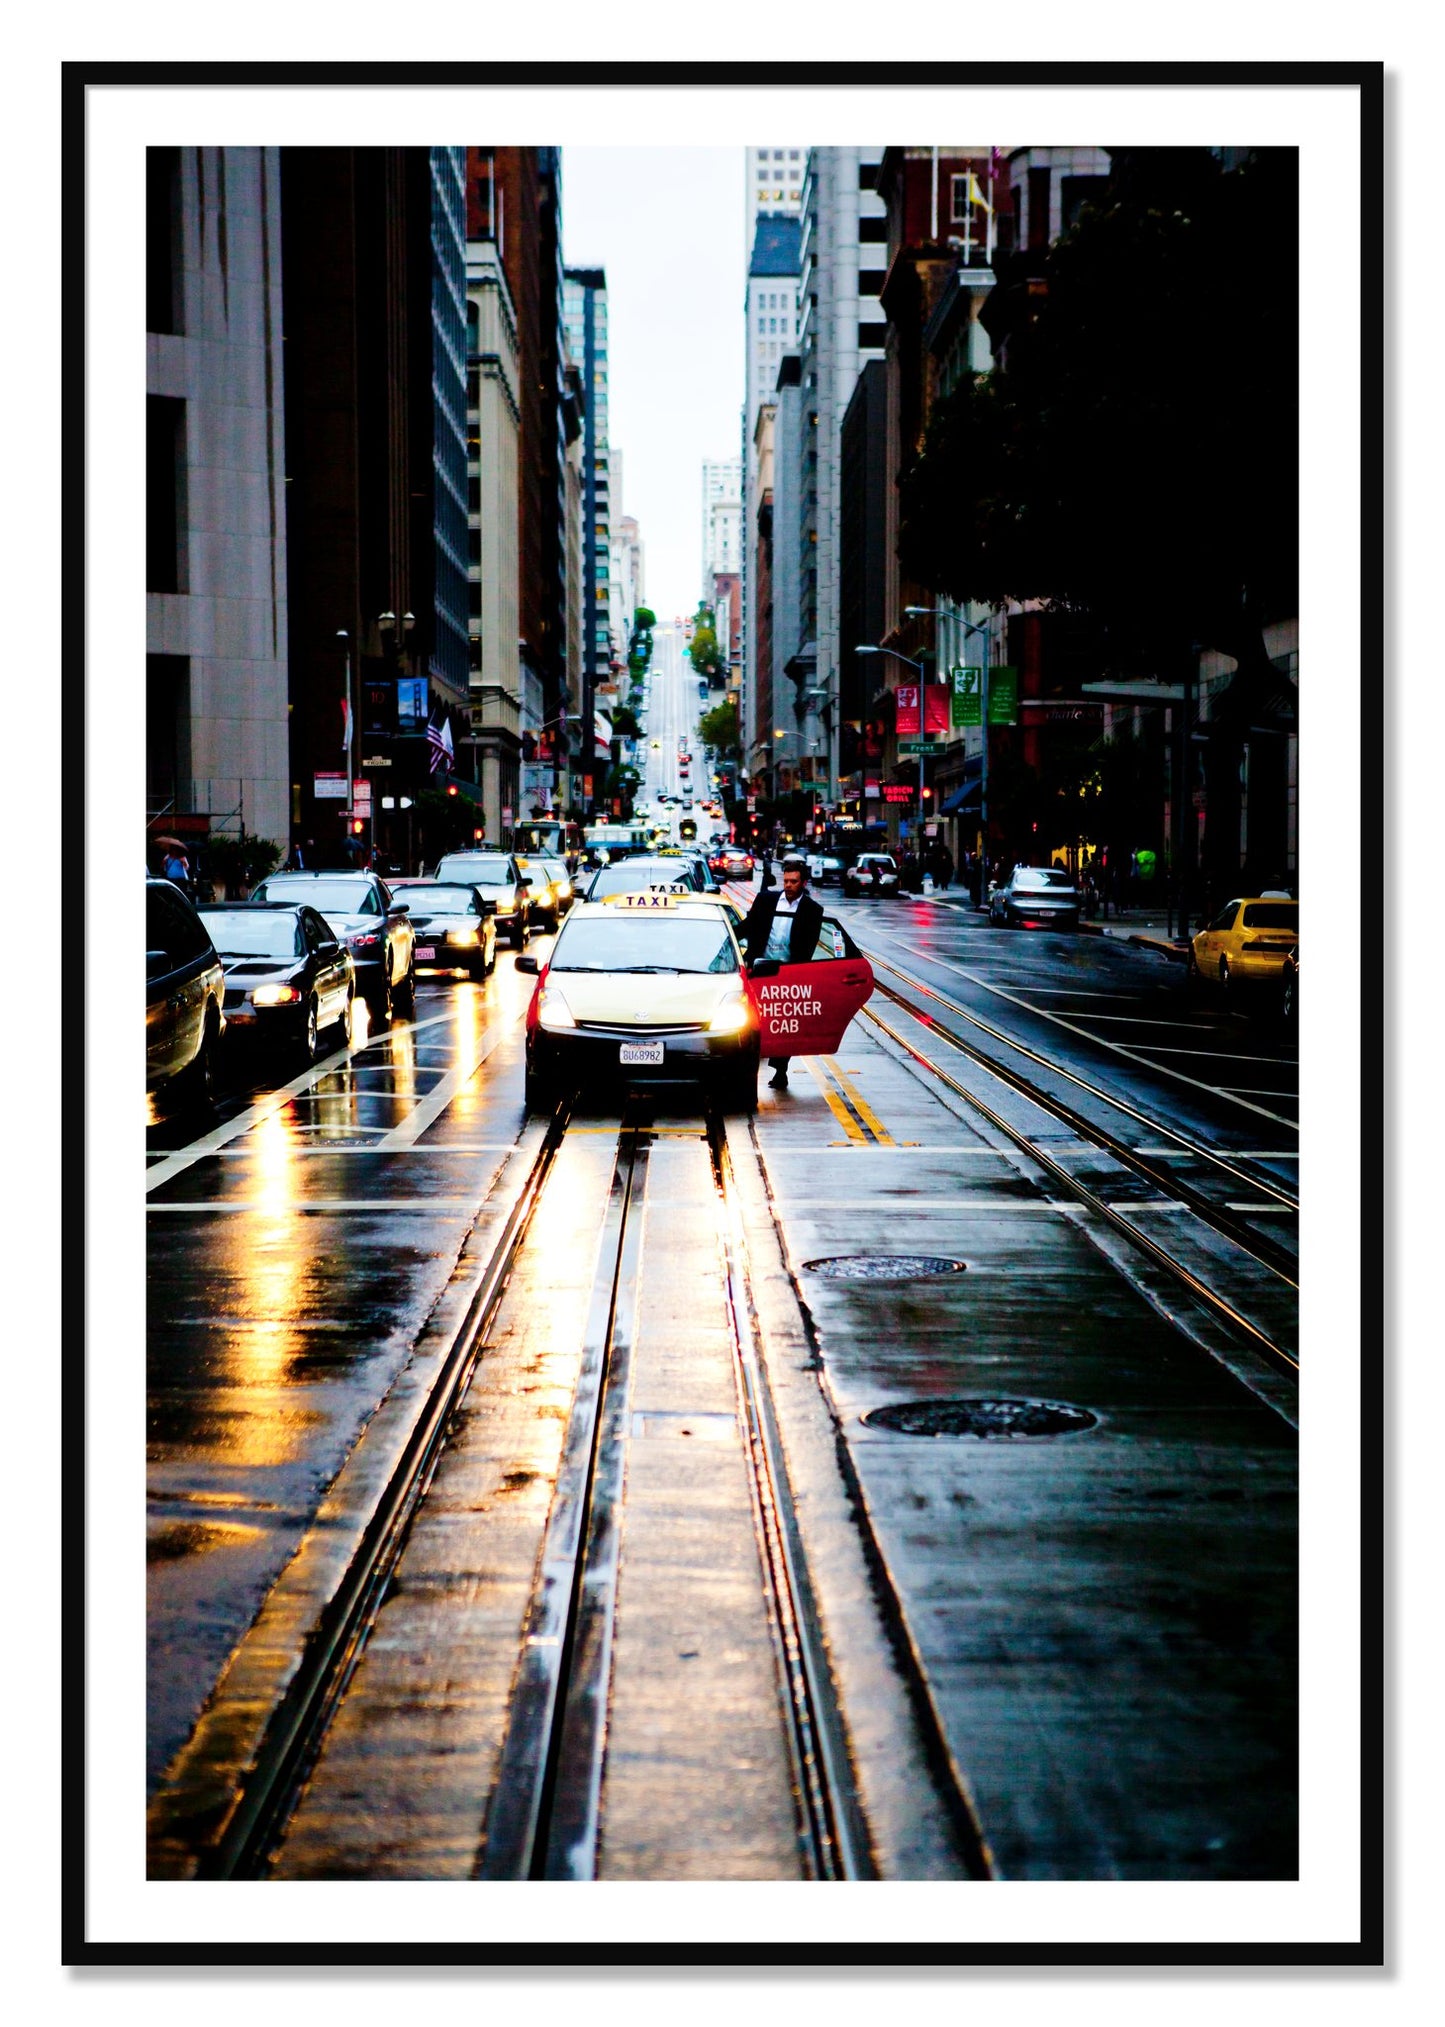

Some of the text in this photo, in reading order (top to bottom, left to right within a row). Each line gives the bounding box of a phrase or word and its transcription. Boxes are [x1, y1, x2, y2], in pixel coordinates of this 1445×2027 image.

[911, 744, 934, 752] Front
[882, 786, 914, 795] TADICH
[886, 795, 910, 803] GRILL
[650, 885, 684, 893] TAXI
[626, 896, 668, 906] TAXI
[760, 984, 812, 1000] ARROW
[769, 1019, 799, 1034] CAB
